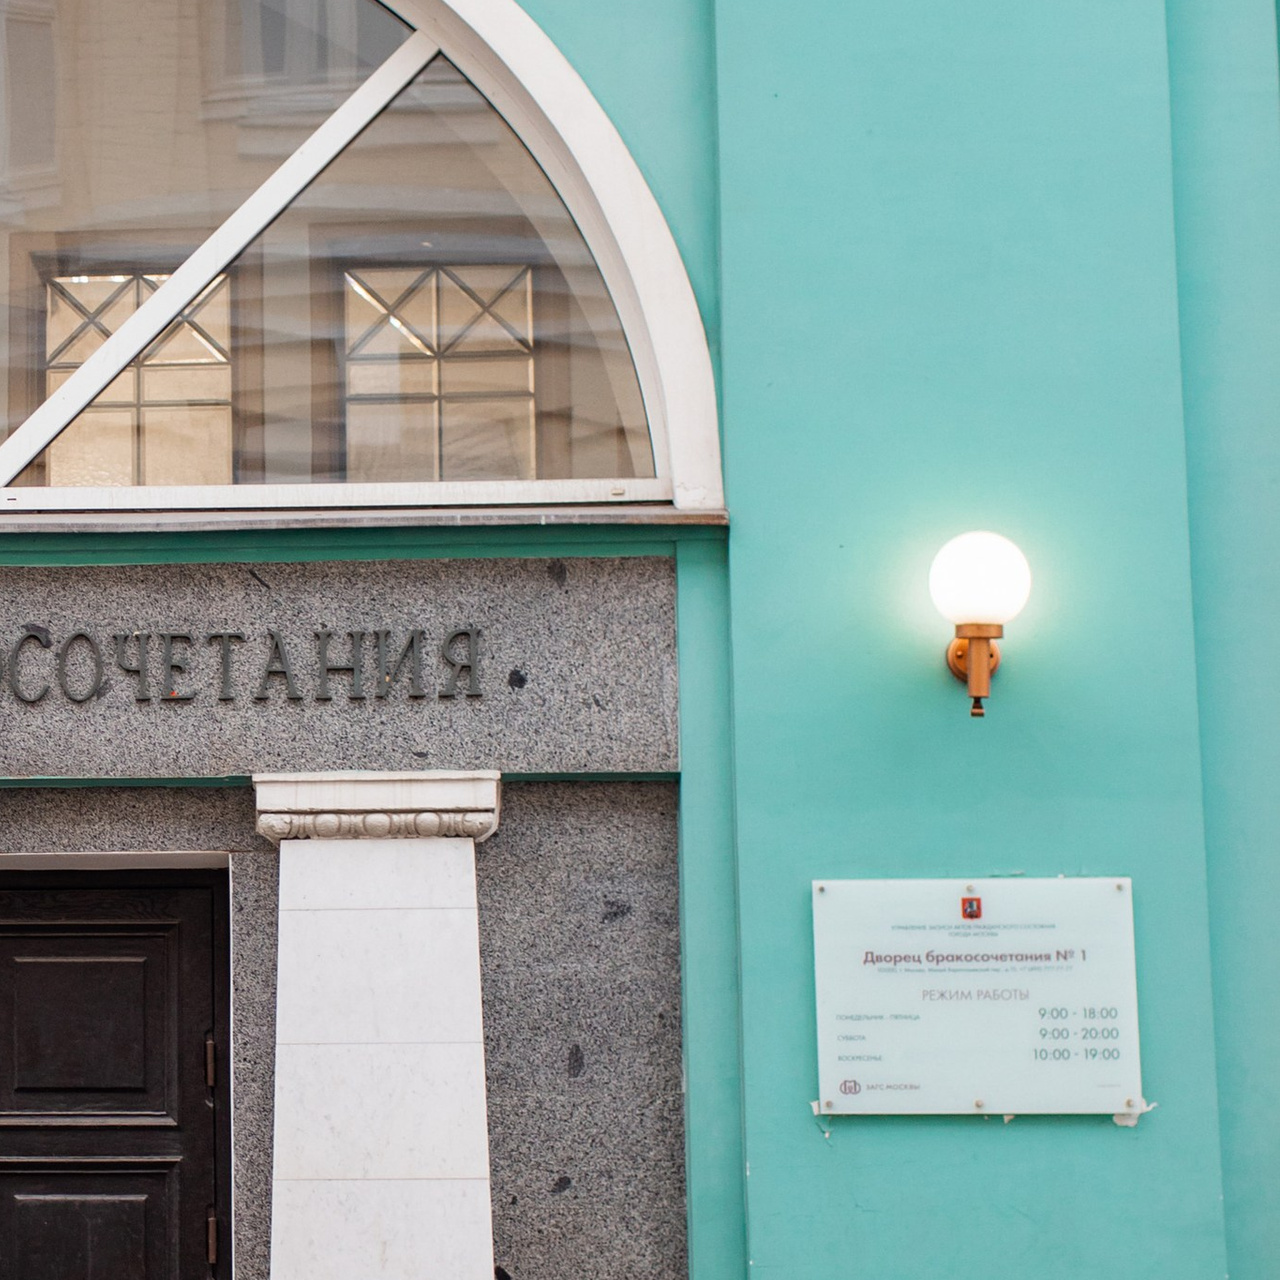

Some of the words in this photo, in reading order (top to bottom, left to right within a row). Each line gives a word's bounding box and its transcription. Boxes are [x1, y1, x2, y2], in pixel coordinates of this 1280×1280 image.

[863, 951, 921, 966] Дворец
[925, 950, 1051, 965] бракосочетания
[1081, 949, 1086, 961] 1
[922, 989, 972, 1001] РЕЖИМ
[977, 988, 1029, 1001] РАБОТЫ
[1038, 1007, 1069, 1019] 9:00
[1083, 1006, 1118, 1019] 18:00
[1039, 1027, 1070, 1040] 9:00
[1080, 1027, 1119, 1040] 20:00
[1033, 1048, 1071, 1060] 10:00
[1084, 1047, 1120, 1060] 19:00
